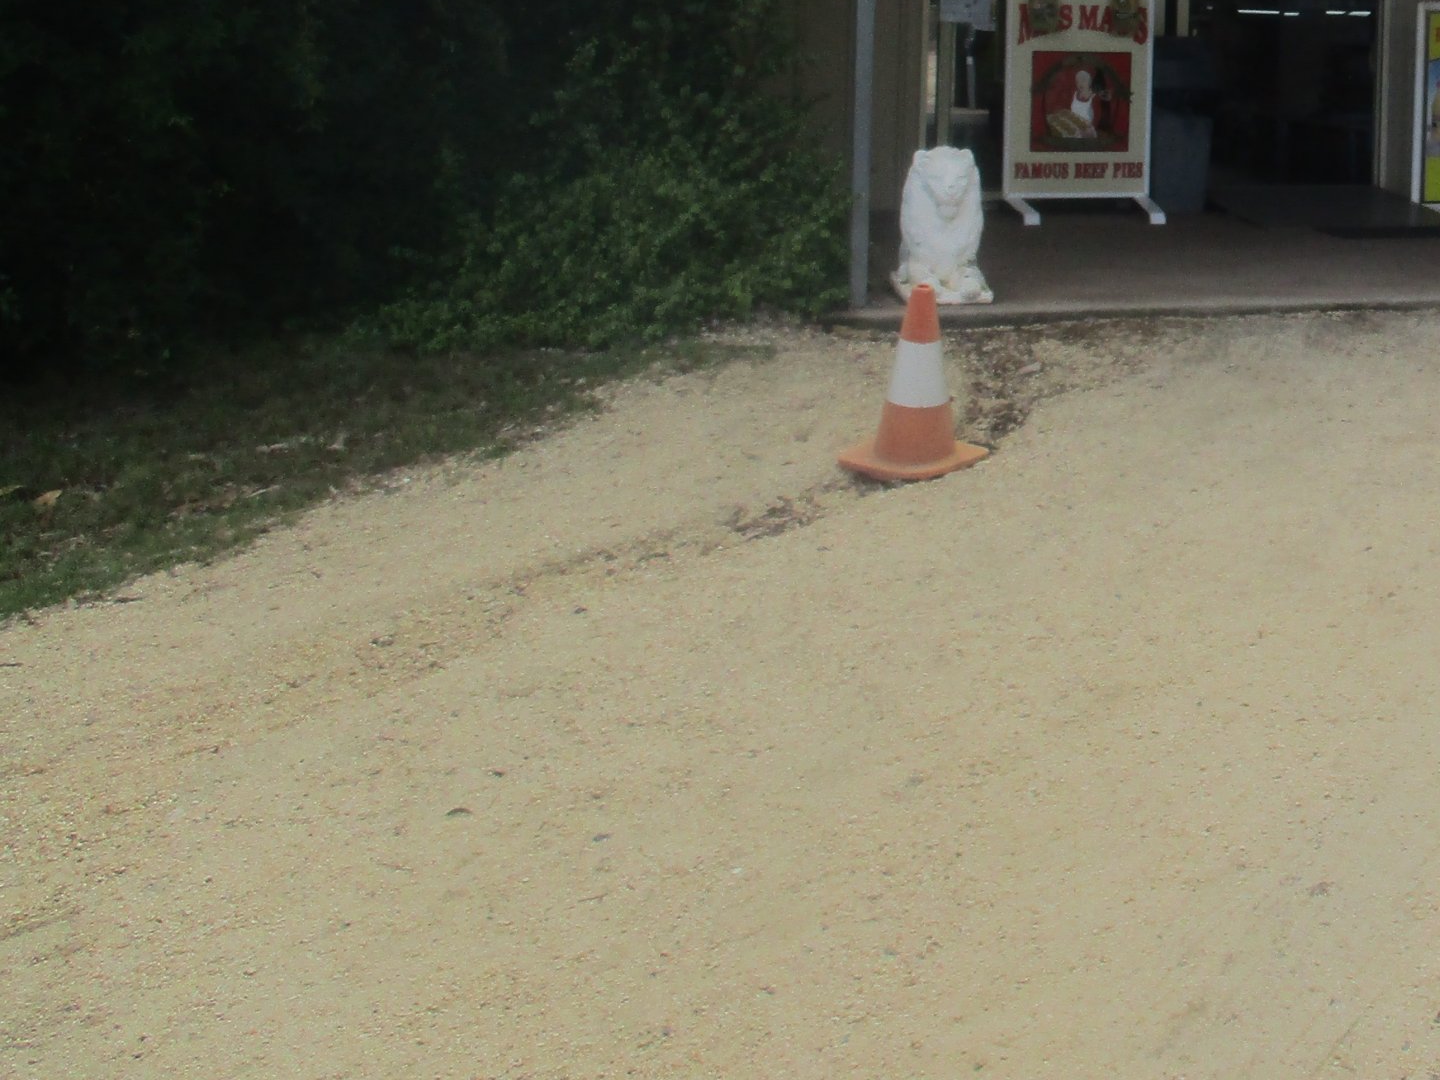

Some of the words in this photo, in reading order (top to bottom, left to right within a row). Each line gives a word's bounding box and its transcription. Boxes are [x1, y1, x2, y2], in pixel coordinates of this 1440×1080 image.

[1018, 3, 1073, 45] MS
[1014, 161, 1069, 180] FAMOUS
[1074, 162, 1109, 180] BEEF
[1113, 162, 1144, 179] PIES
